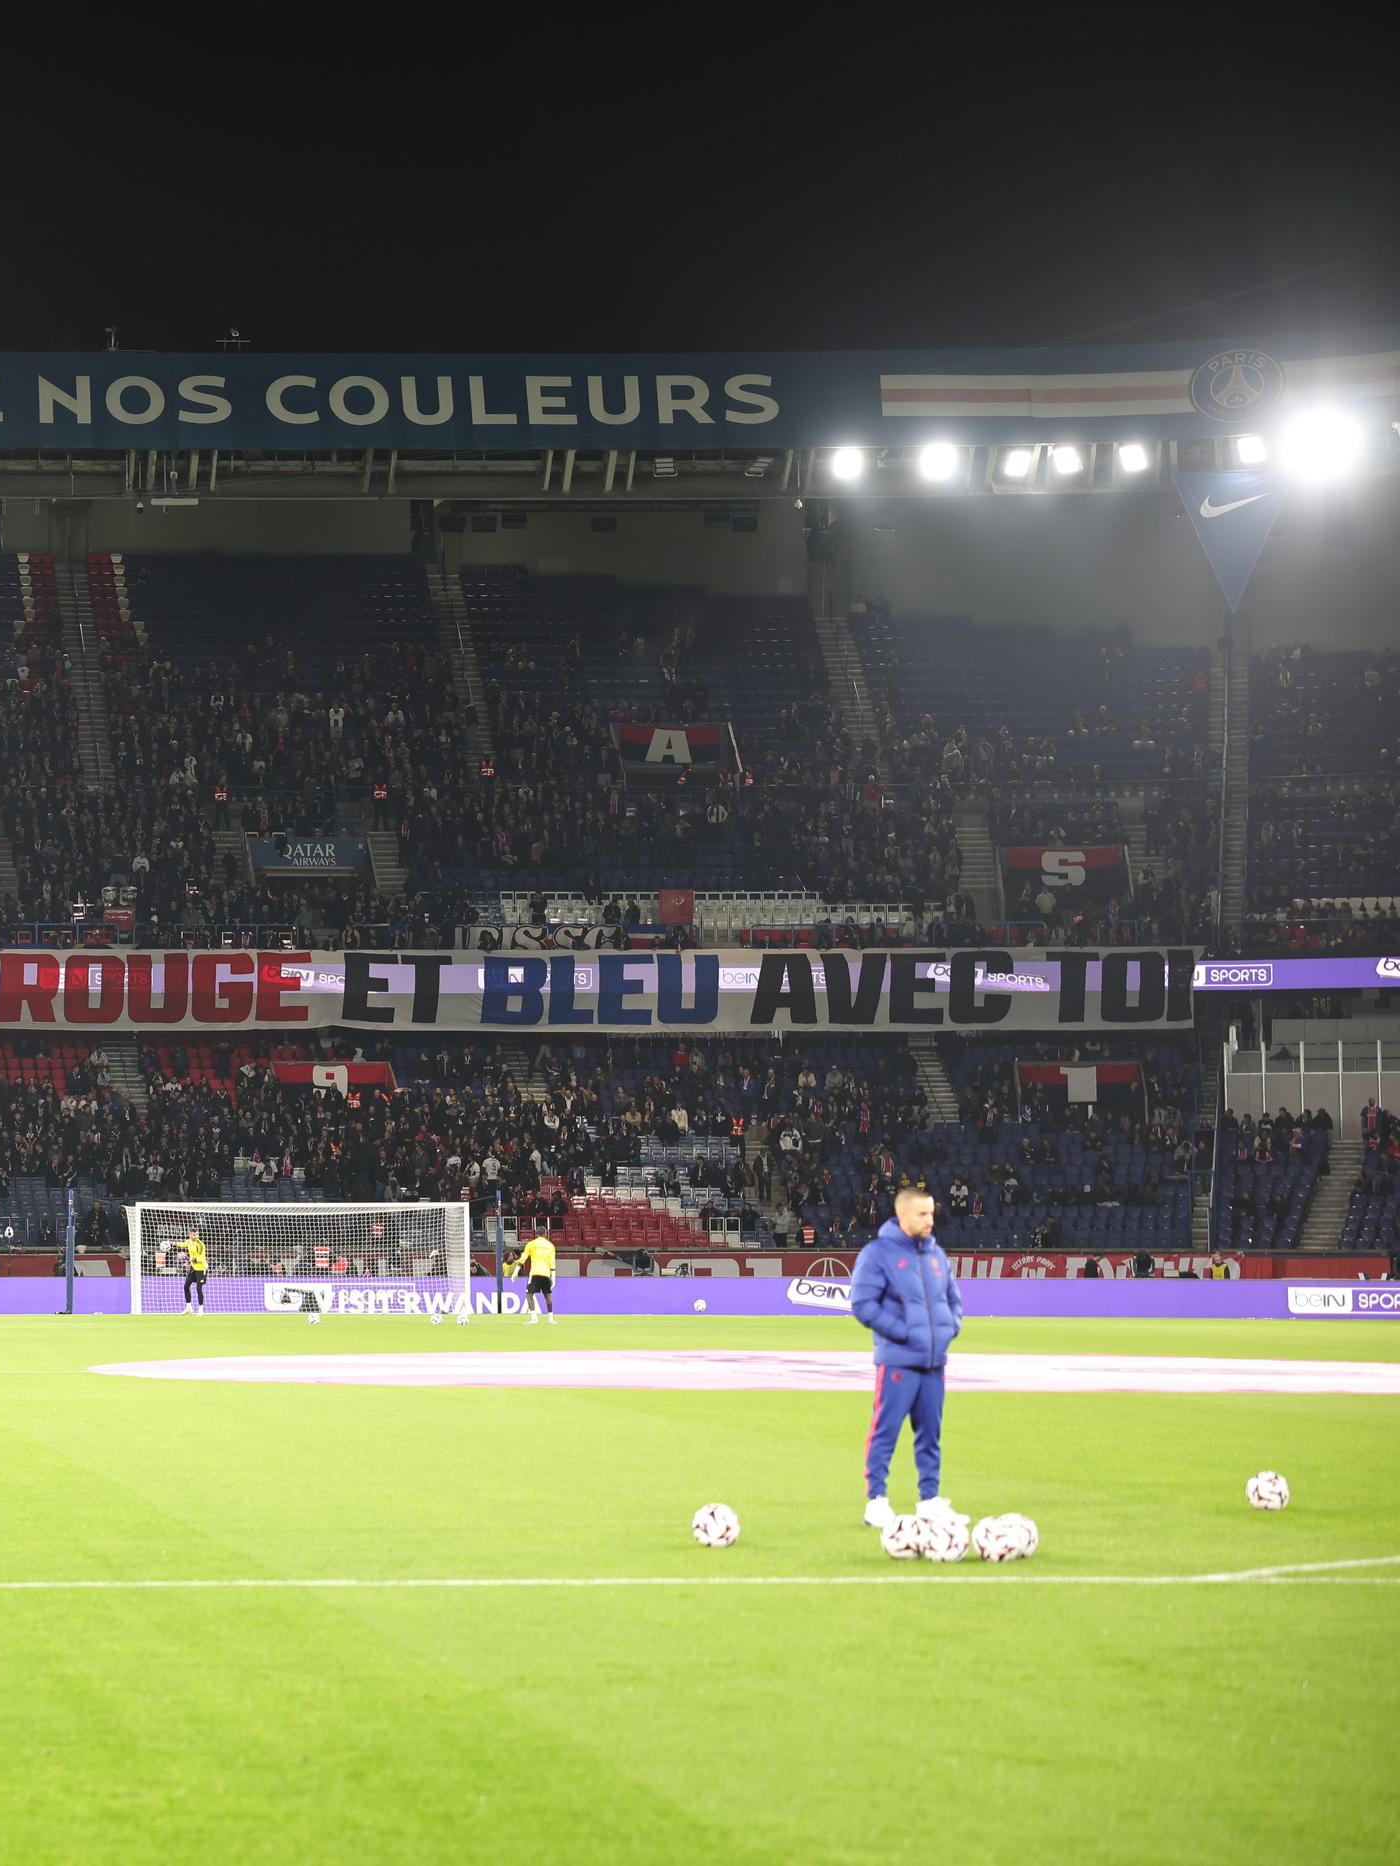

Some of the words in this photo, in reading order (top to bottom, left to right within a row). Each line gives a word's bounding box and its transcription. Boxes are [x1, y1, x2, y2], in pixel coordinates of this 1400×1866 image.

[1208, 353, 1267, 372] PARIS
[38, 375, 232, 425] NOS
[265, 374, 780, 425] COULEURS
[645, 728, 692, 763] A
[291, 858, 336, 866] AIRWAYS
[1041, 851, 1086, 886] S
[1210, 968, 1267, 982] SPORTS
[342, 952, 453, 1023] ET
[480, 953, 719, 1025] BLEU
[750, 951, 1014, 1024] AVEC
[1046, 949, 1195, 1023] TOI
[405, 1291, 542, 1314] RWANDA
[1294, 1289, 1345, 1307] beIN
